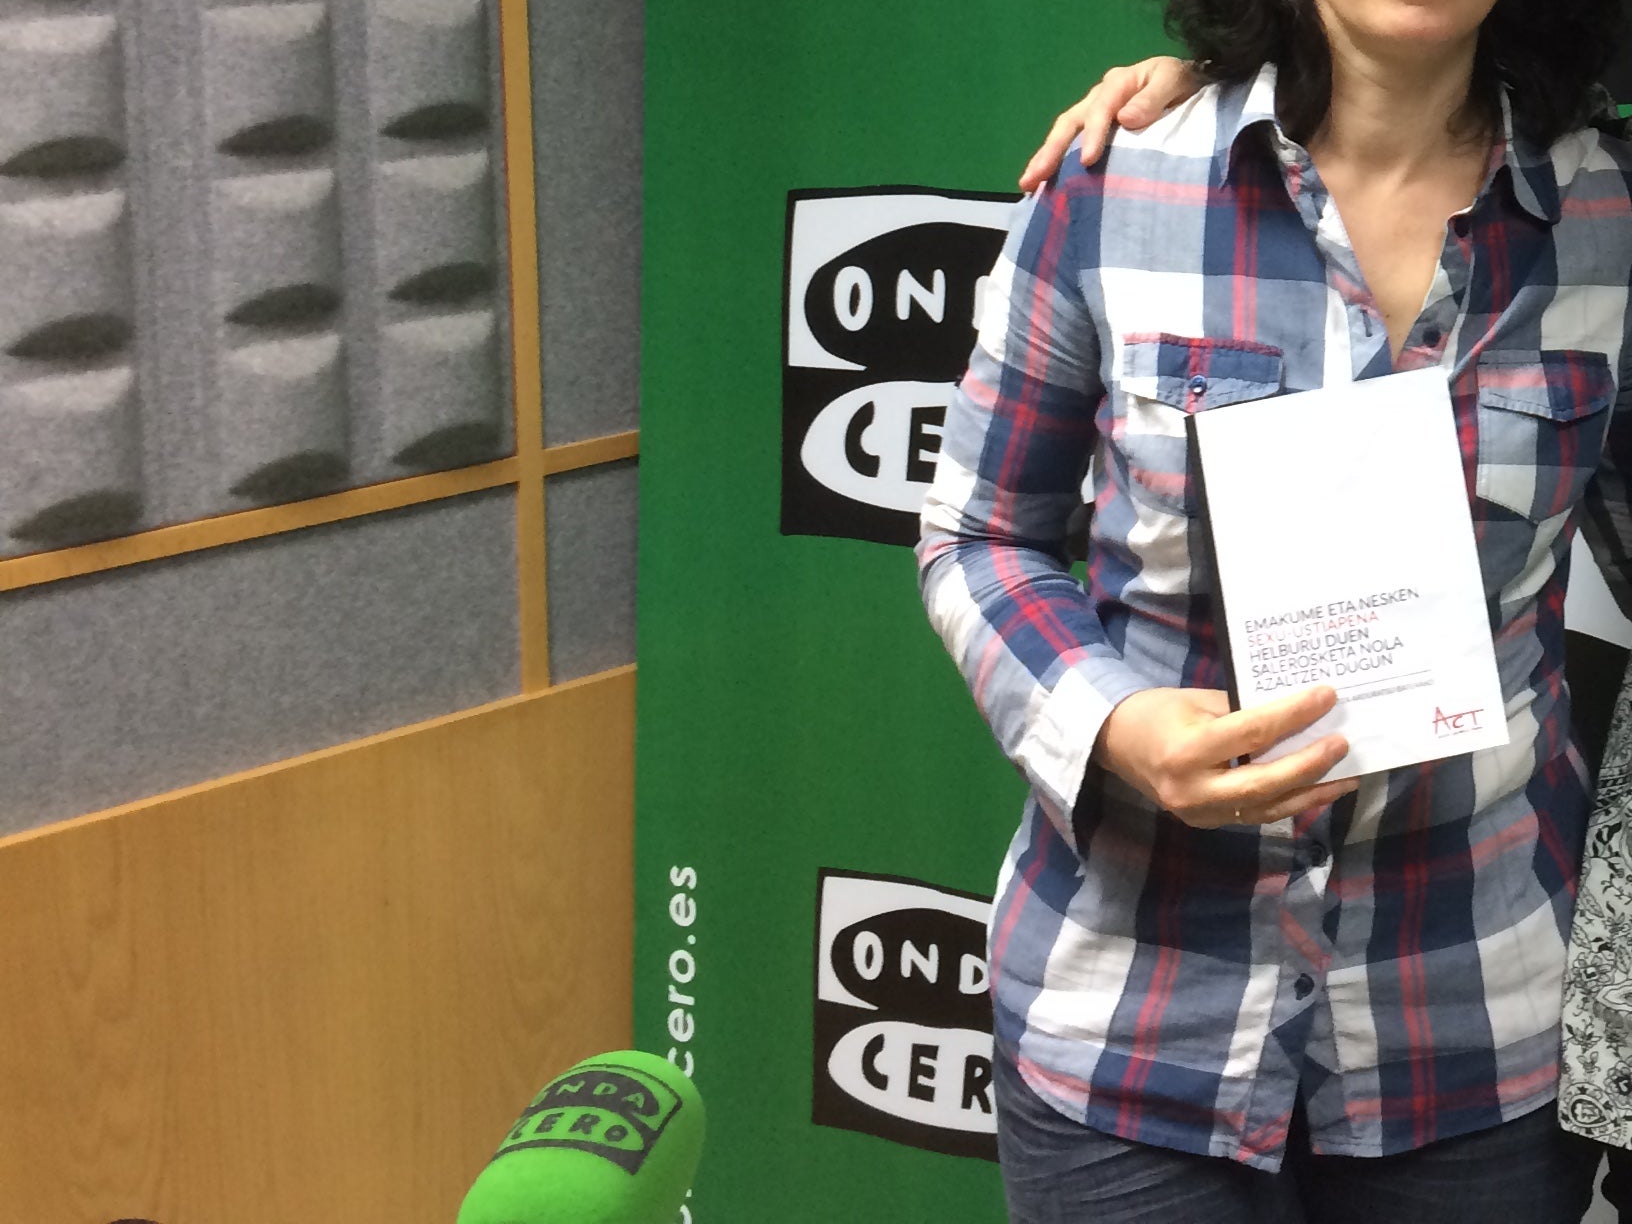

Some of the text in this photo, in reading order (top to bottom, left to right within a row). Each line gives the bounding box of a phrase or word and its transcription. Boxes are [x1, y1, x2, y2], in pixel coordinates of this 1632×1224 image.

[844, 400, 948, 484] CE
[1244, 587, 1420, 633] EMAKUME ETA NESKEN
[1248, 611, 1380, 648] SEXU-USTIAPENA
[1249, 627, 1370, 662] HELBURU DUEN
[1251, 635, 1404, 678] SALEROSKETA NOLA
[1255, 653, 1394, 693] AZALTZEN DUGUN
[853, 930, 990, 995] OND
[861, 1033, 993, 1114] CER
